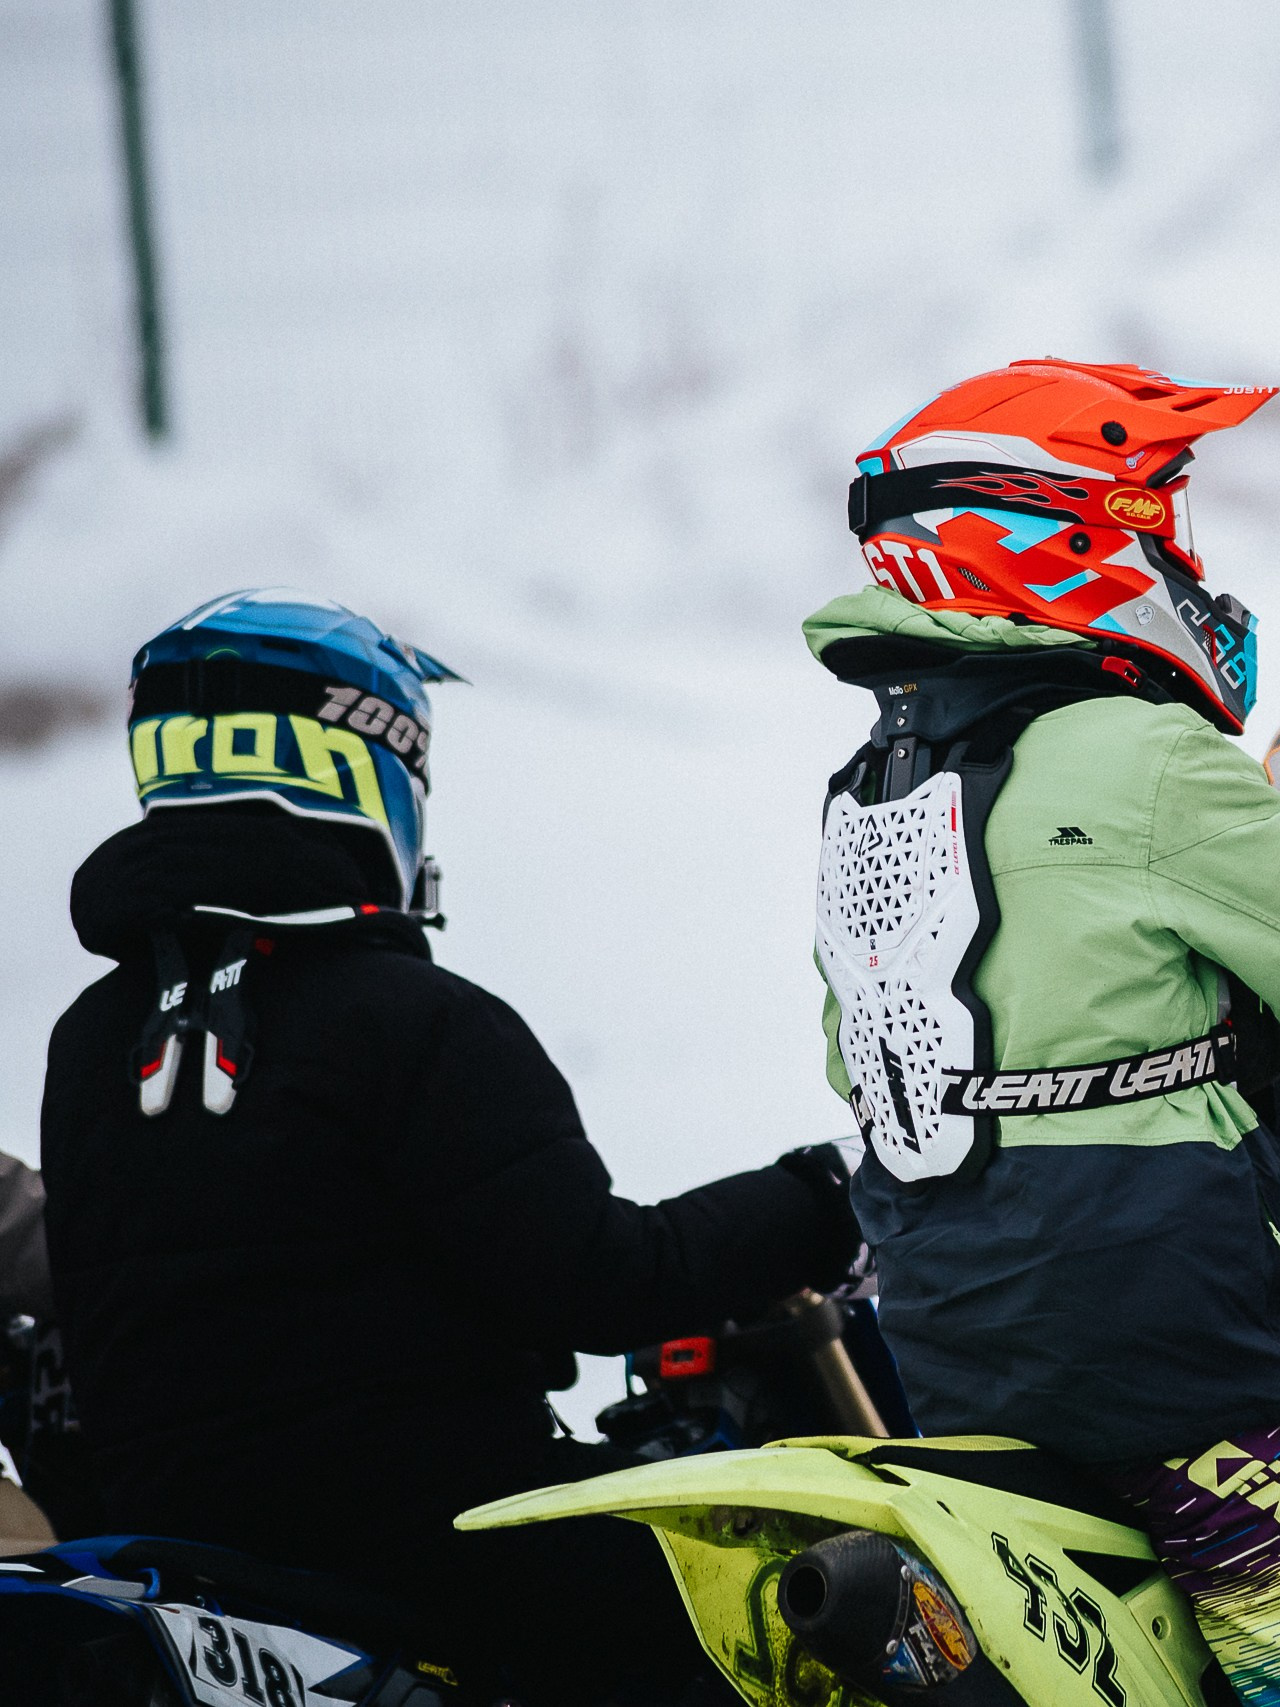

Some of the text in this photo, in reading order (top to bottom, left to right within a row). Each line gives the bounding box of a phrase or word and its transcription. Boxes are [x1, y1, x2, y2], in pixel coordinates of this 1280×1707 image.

[1111, 497, 1161, 516] FMF
[1047, 837, 1094, 846] TRESPASS
[961, 1068, 1106, 1110] LEATT
[197, 1616, 297, 1707] 318
